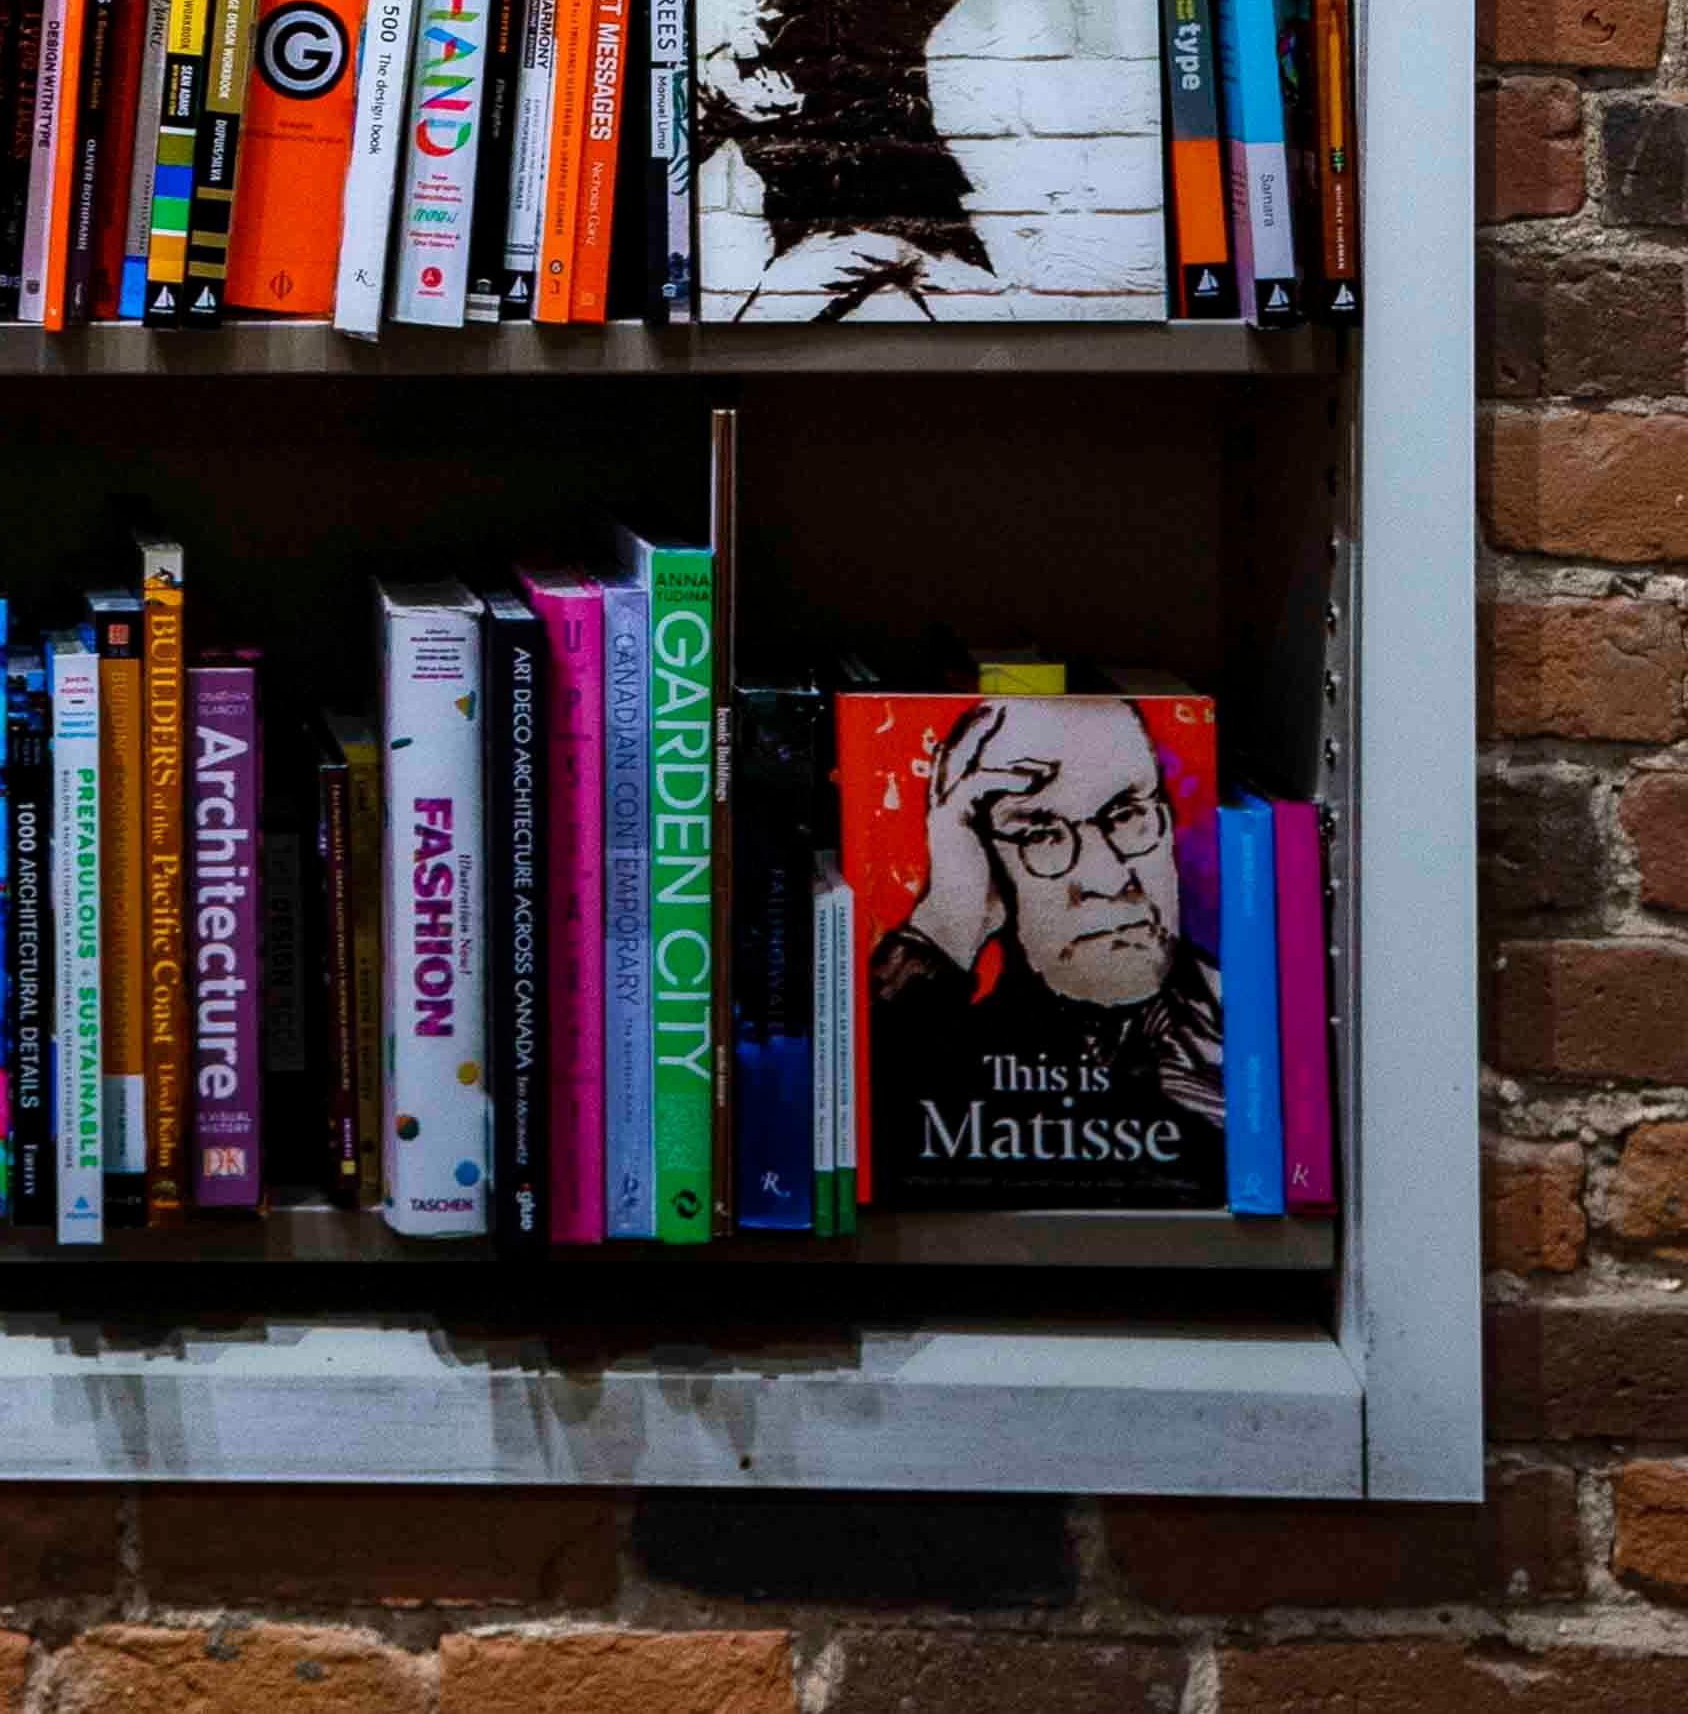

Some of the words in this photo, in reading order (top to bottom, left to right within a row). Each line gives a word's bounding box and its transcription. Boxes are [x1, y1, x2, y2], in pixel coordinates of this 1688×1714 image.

[377, 54, 392, 76] The
[380, 5, 397, 43] 500
[1174, 23, 1201, 90] type
[371, 78, 391, 120] design
[591, 23, 621, 142] MESSAGES
[368, 124, 386, 156] book
[657, 609, 711, 904] GARDEN
[17, 802, 37, 851] 1000
[77, 767, 97, 959] PREFABULOUS
[18, 857, 39, 1020] ARCHITECTURAL
[195, 725, 249, 1100] Architecture
[413, 797, 455, 1038] FASHION
[657, 929, 711, 1081] CITY
[19, 1026, 39, 1109] DETAILS
[77, 986, 98, 1168] SUSTAINABLE
[983, 1053, 1068, 1093] This
[1078, 1053, 1111, 1093] is
[918, 1098, 1183, 1162] Matisse
